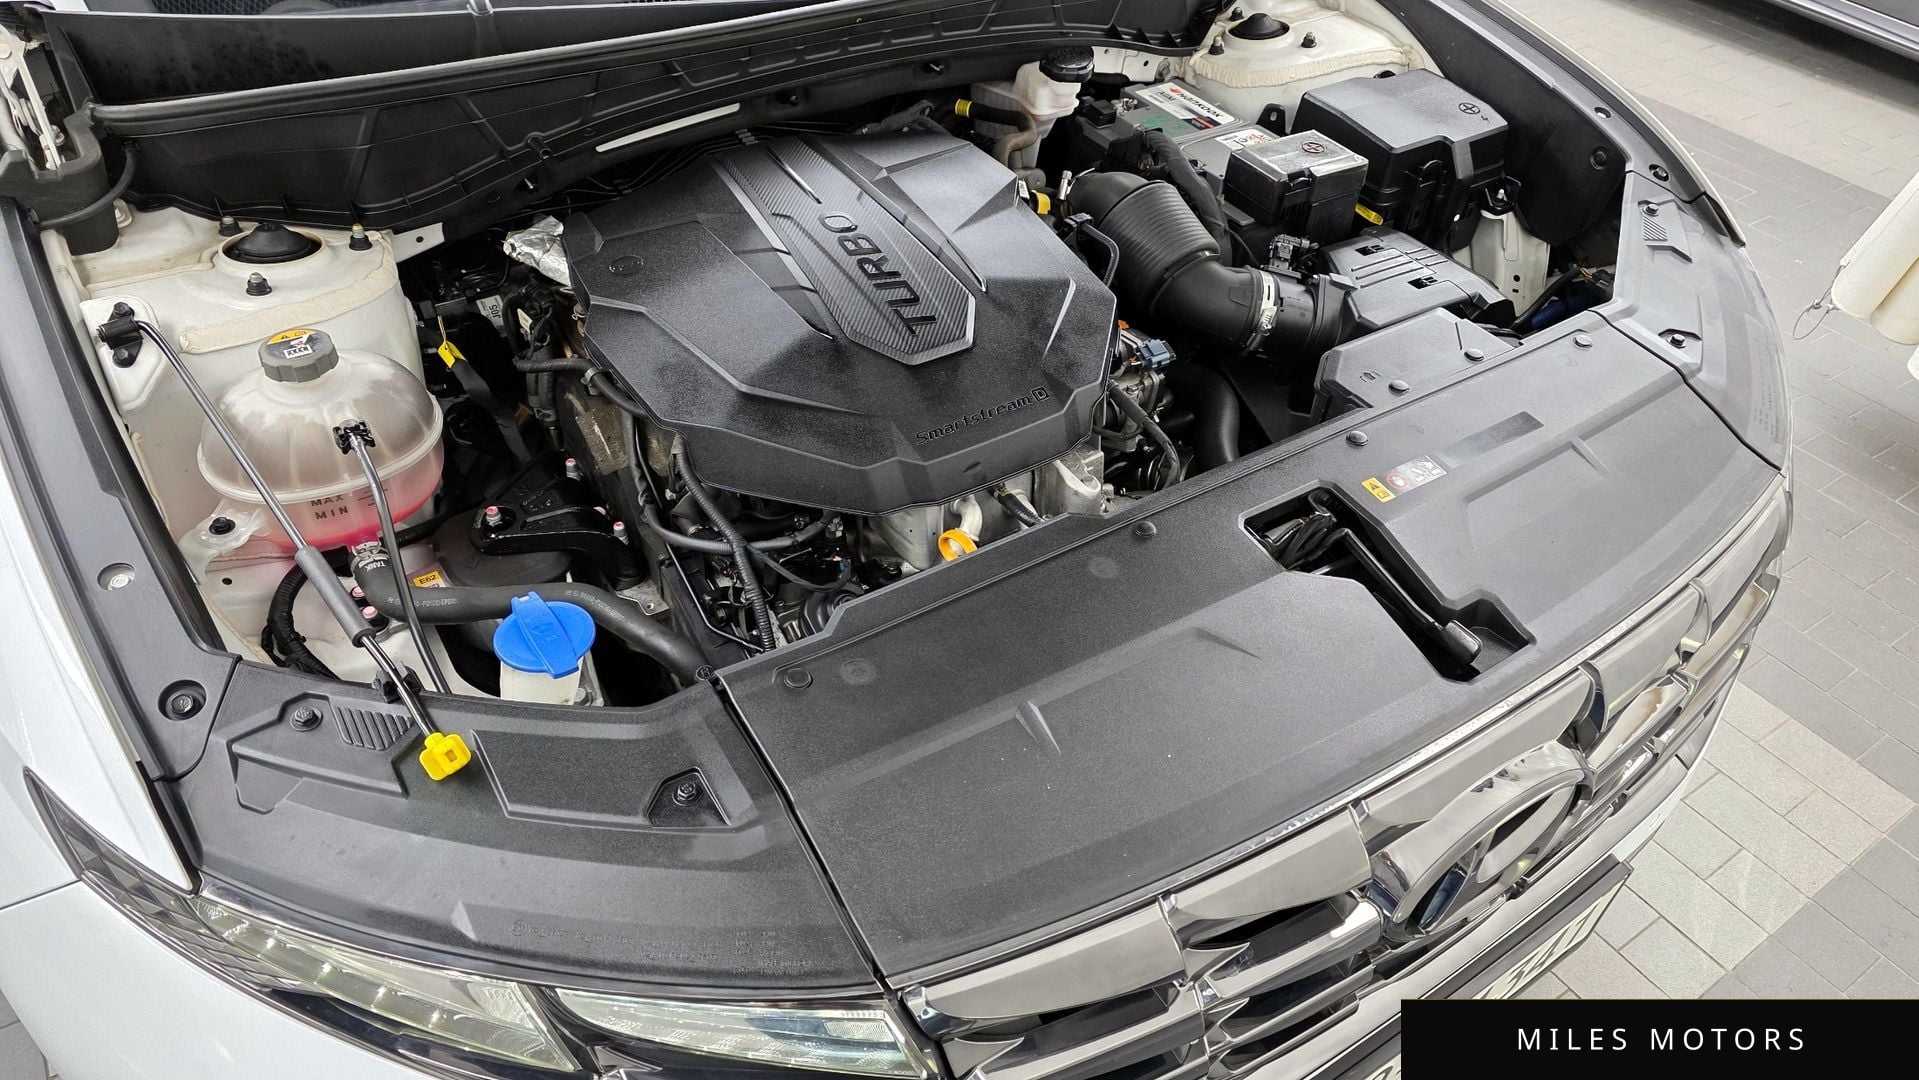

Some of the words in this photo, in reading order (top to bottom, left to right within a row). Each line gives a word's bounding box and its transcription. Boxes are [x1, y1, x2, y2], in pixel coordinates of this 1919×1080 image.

[818, 212, 937, 337] TURBO
[915, 396, 1031, 446] Smartstream
[310, 495, 343, 507] MAX
[314, 506, 348, 520] MIN
[365, 560, 386, 572] TANK
[419, 574, 437, 585] E62
